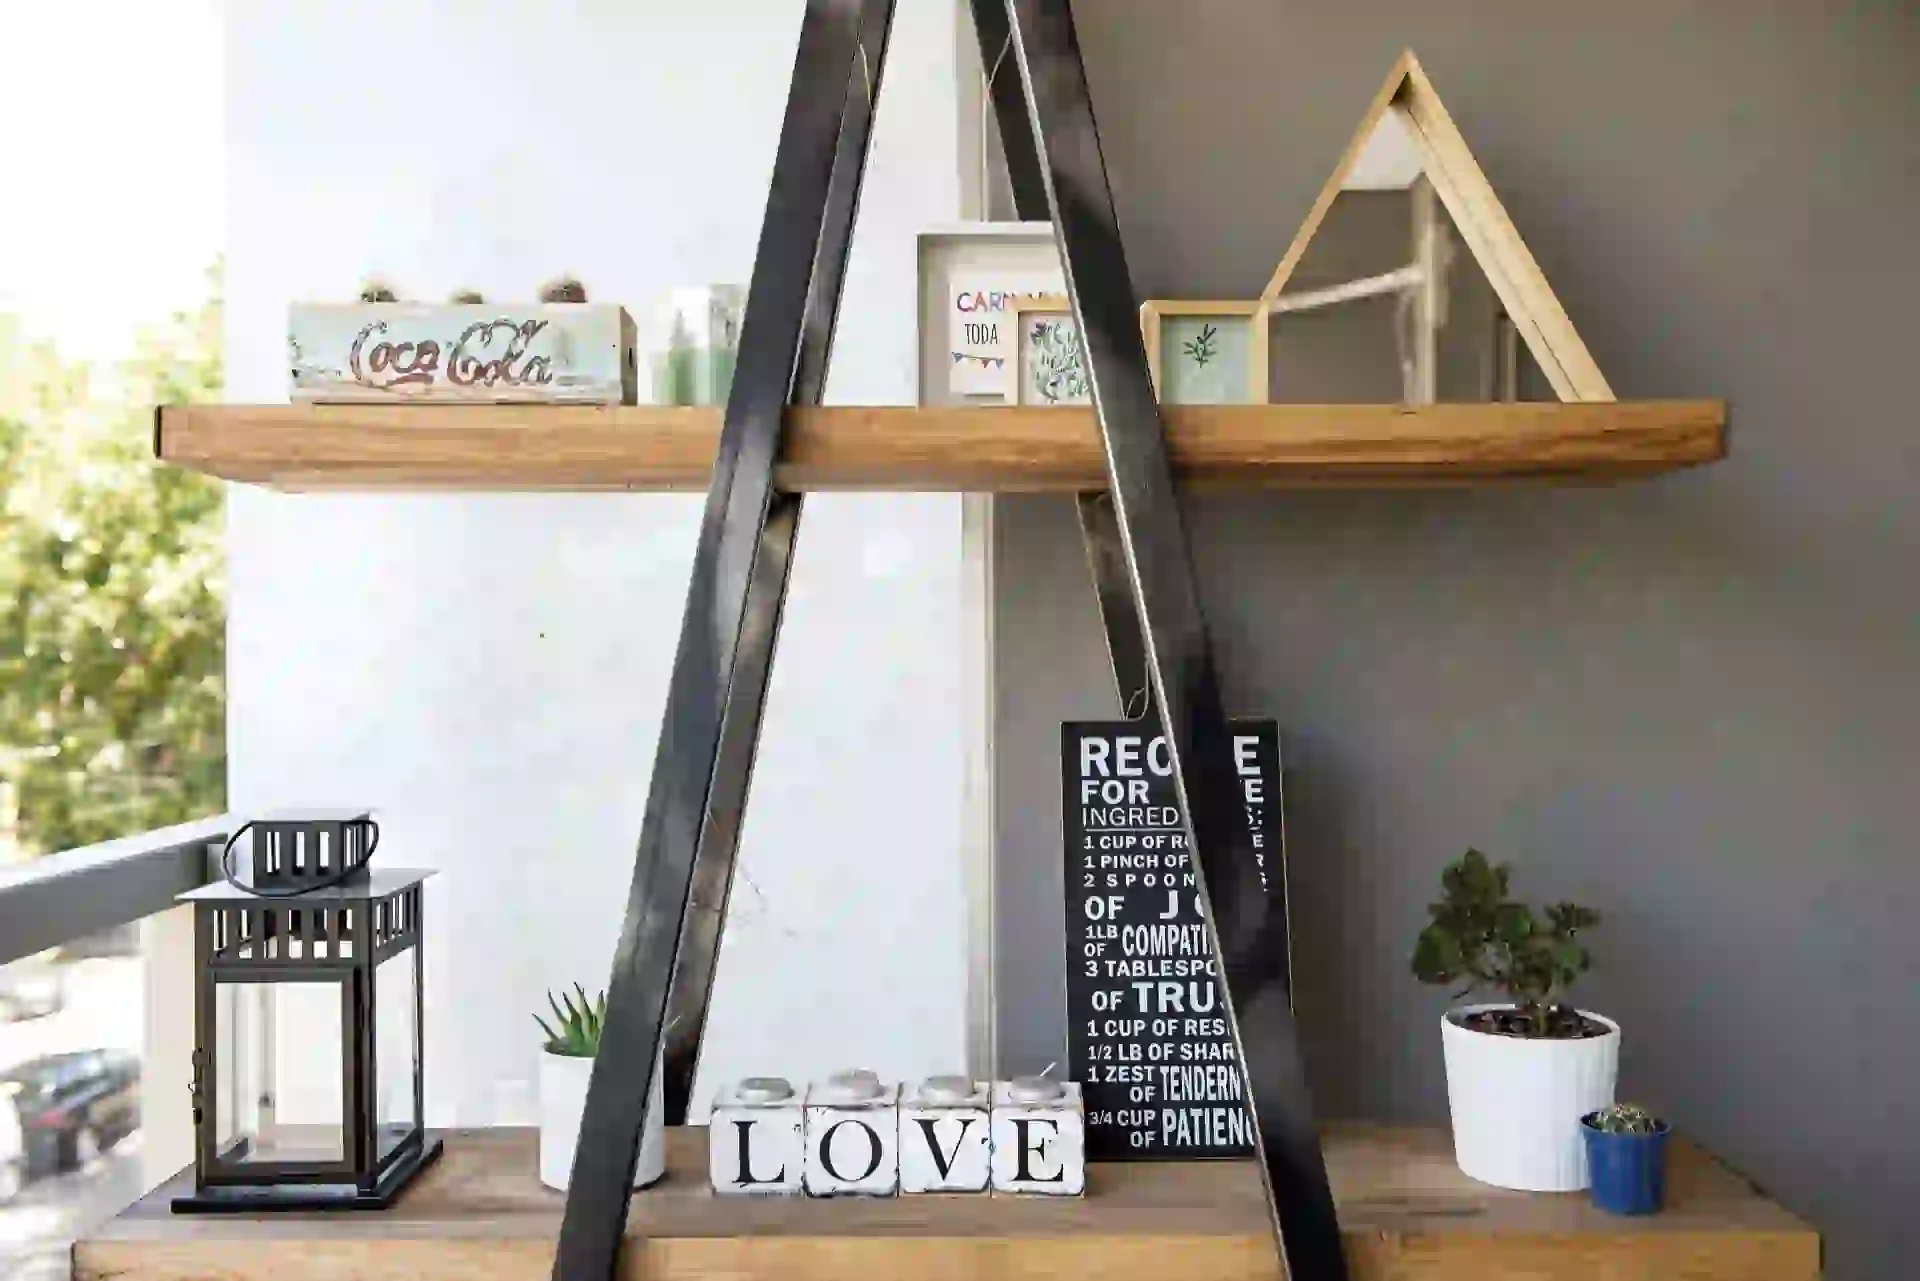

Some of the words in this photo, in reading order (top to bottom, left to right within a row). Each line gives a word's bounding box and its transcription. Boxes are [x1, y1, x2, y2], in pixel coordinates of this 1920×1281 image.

[1080, 735, 1261, 777] RECE
[1082, 780, 1149, 804] FOR
[1084, 836, 1094, 849] 1
[1100, 836, 1136, 849] CUP
[1142, 836, 1167, 848] OF
[1084, 856, 1096, 868] 1
[1101, 855, 1158, 868] PINCH
[1165, 855, 1188, 868] OF
[1084, 873, 1094, 887] 2
[1085, 896, 1124, 920] OF
[1122, 923, 1212, 956] COMPATI
[1084, 943, 1107, 956] OF
[1085, 960, 1098, 976] 3
[1104, 959, 1217, 978] TABLESPO
[1092, 991, 1124, 1011] OF
[1131, 981, 1215, 1013] TRU
[1088, 1020, 1099, 1036] 1
[1105, 1020, 1145, 1036] CUP
[1152, 1019, 1178, 1036] OF
[1089, 1045, 1111, 1060] 1/2
[1119, 1044, 1142, 1060] LB
[1148, 1043, 1174, 1060] OF
[1179, 1042, 1236, 1061] SHAR
[1088, 1066, 1099, 1082] 1
[1105, 1066, 1155, 1082] ZEST
[1159, 1065, 1241, 1101] TENDERN
[1130, 1086, 1155, 1102] OF
[1090, 1110, 1112, 1124] 3/4
[1117, 1110, 1155, 1126] CUP
[1162, 1107, 1255, 1146] PATIEN
[1131, 1131, 1155, 1147] OF
[732, 1119, 1064, 1183] LOVE
